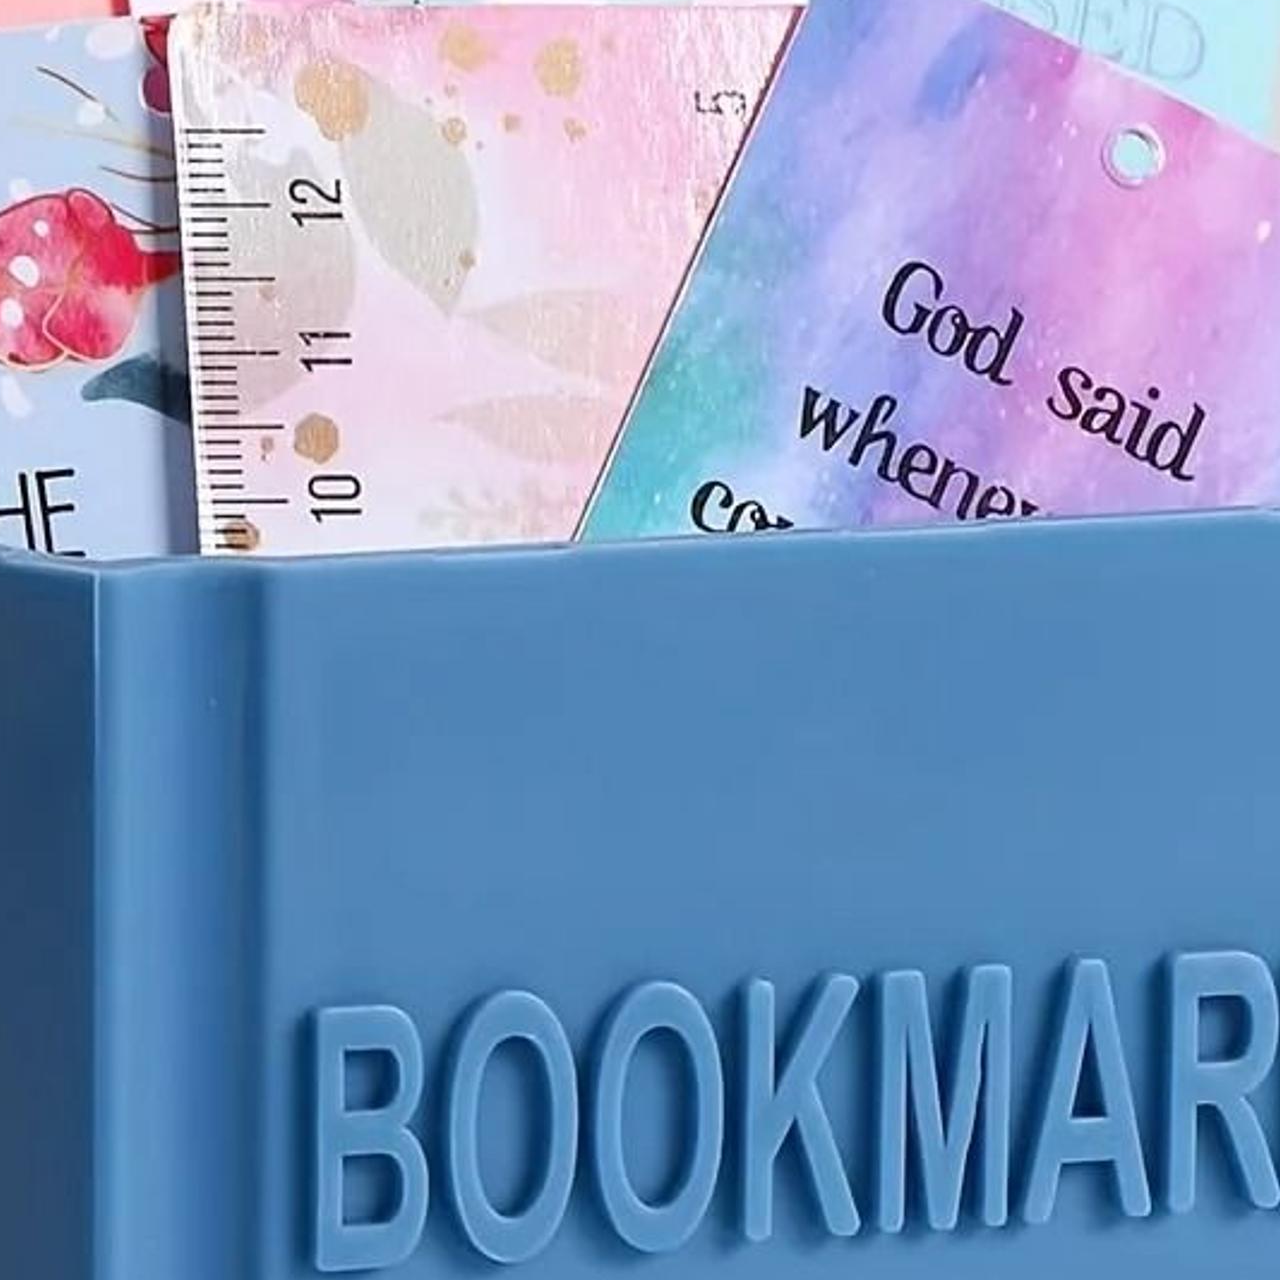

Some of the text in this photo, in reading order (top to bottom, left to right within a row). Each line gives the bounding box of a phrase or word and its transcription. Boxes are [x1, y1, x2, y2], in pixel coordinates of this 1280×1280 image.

[289, 178, 343, 227] 12
[299, 332, 353, 372] 11
[882, 261, 1205, 481] God said
[800, 386, 1039, 522] whene
[308, 474, 362, 523] 10
